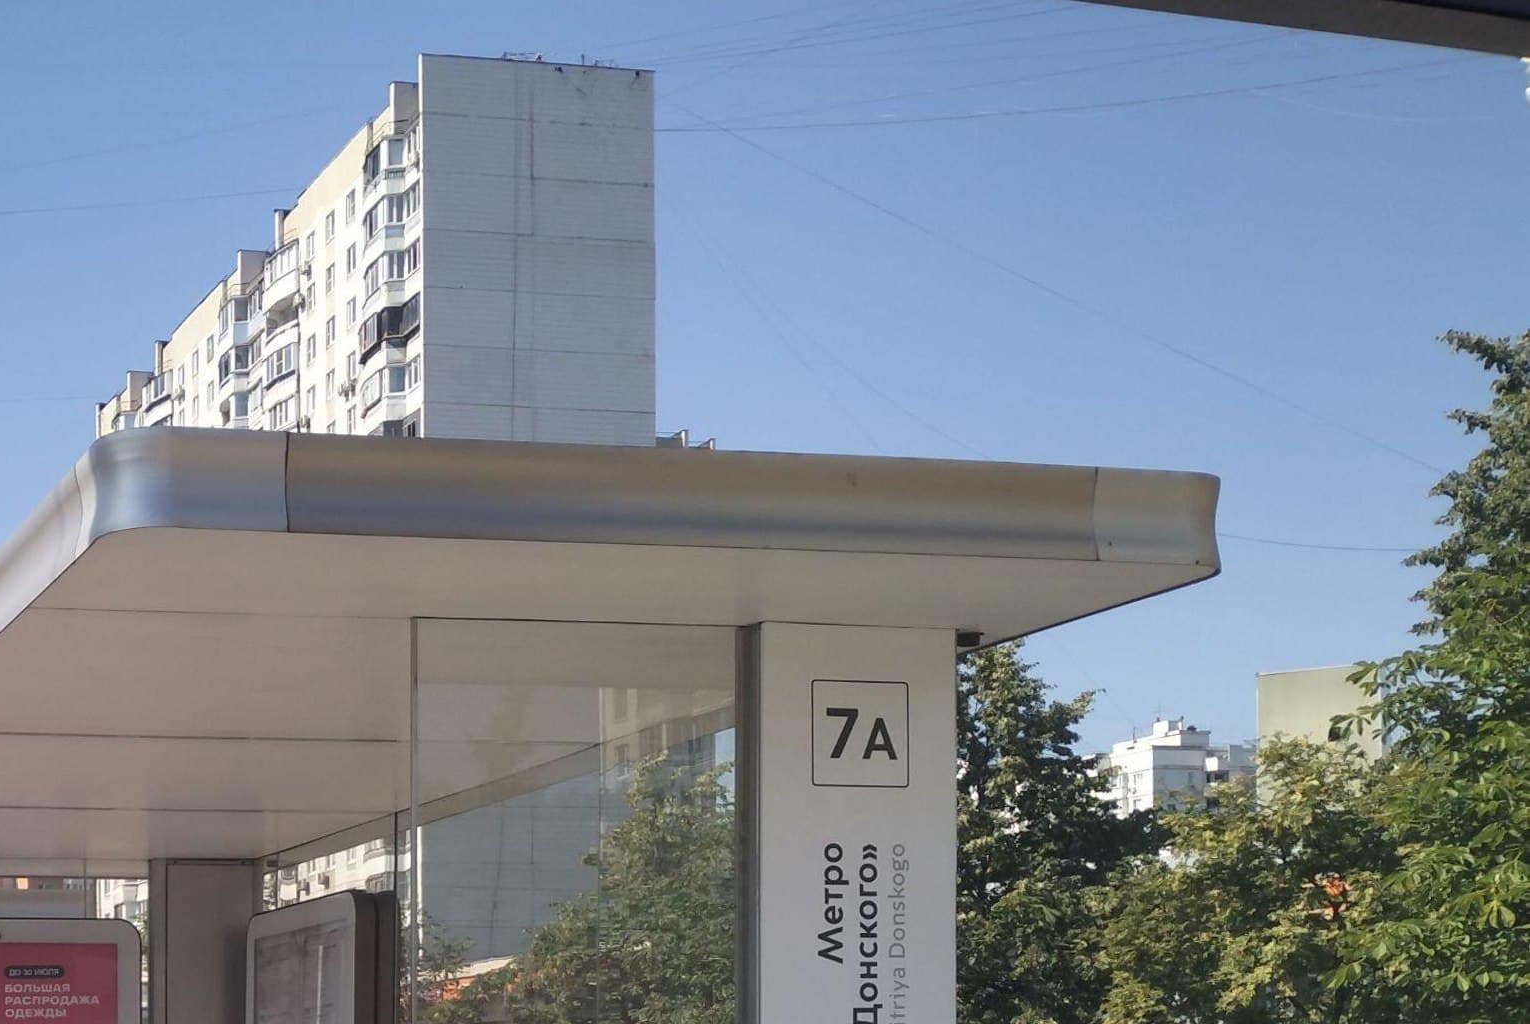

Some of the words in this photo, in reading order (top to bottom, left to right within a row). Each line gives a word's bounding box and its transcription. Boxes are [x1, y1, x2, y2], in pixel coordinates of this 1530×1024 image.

[817, 842, 849, 964] Метро
[887, 843, 910, 959] Donskogo
[4, 983, 71, 993] БОЛЬШАЯ
[5, 995, 100, 1006] РАСПРОДАЖА
[5, 1008, 67, 1018] ОДЕЖДЫ
